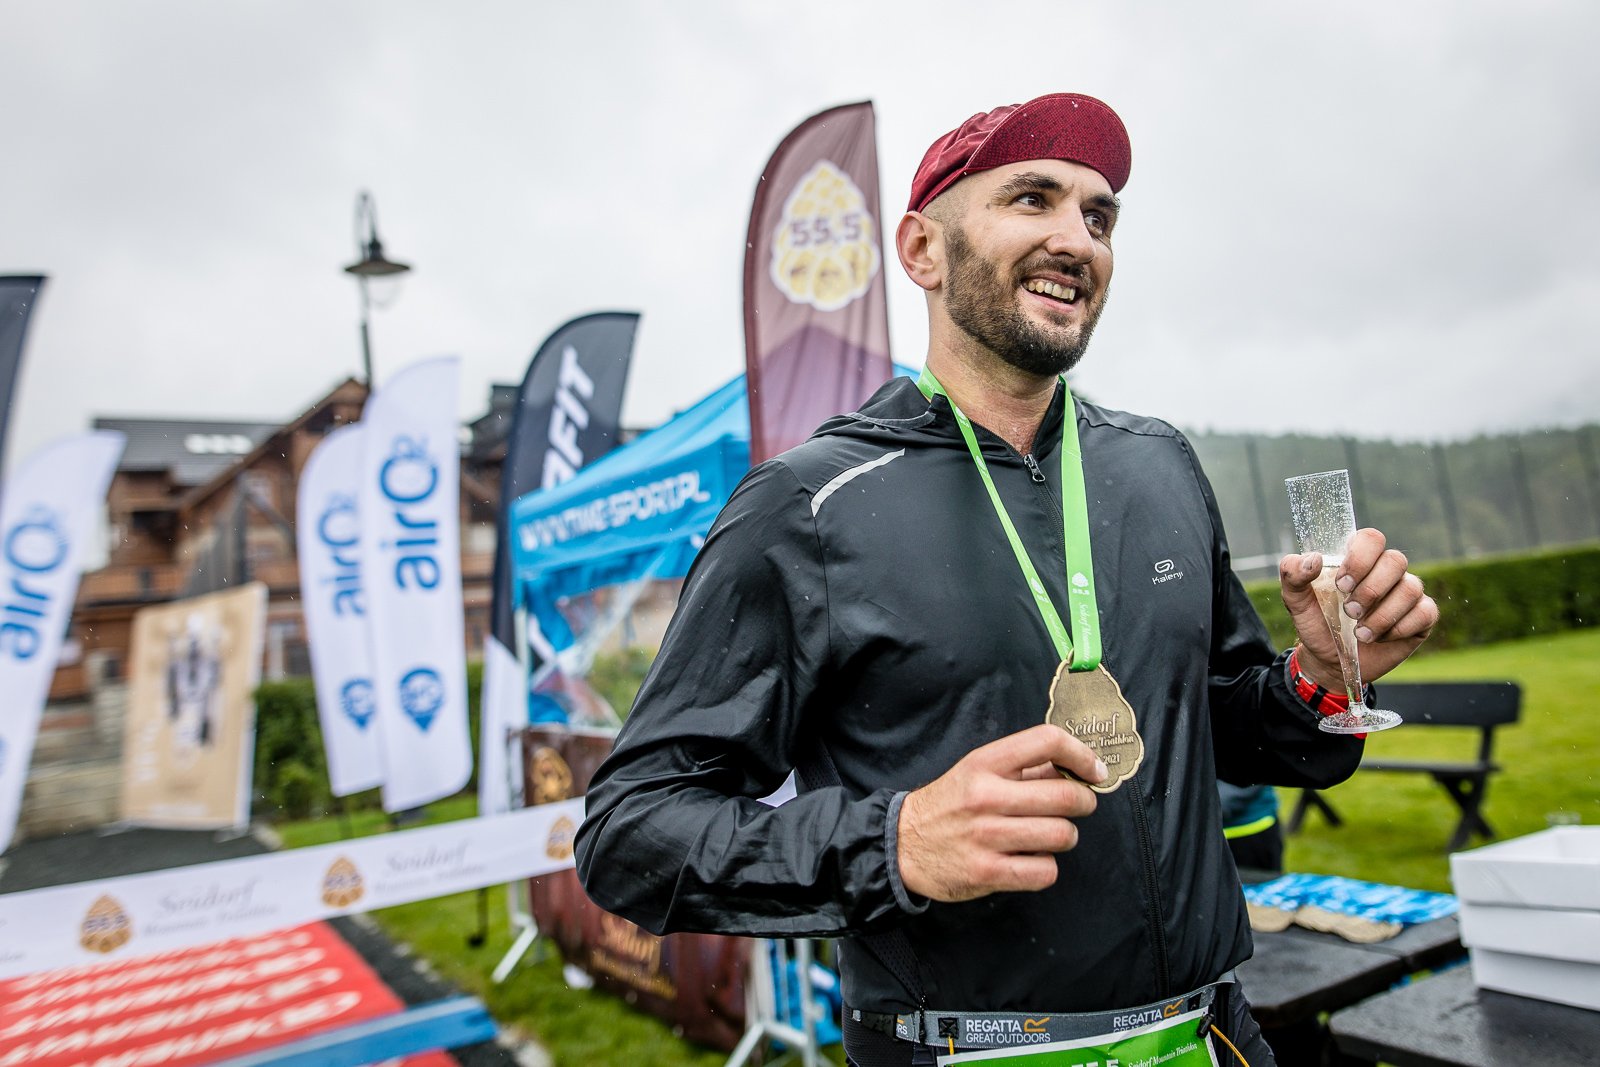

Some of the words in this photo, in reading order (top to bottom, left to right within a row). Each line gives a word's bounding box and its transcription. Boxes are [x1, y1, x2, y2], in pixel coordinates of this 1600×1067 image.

[1151, 571, 1184, 585] Kalenji
[1065, 712, 1120, 738] Seidorf
[1099, 733, 1135, 748] Triathlon
[1103, 753, 1120, 765] 2021
[1113, 1009, 1163, 1028] REGATTA
[966, 1020, 1022, 1033] REGATTA
[966, 1033, 994, 1043] GREAT
[996, 1033, 1051, 1044] OUTDOORS
